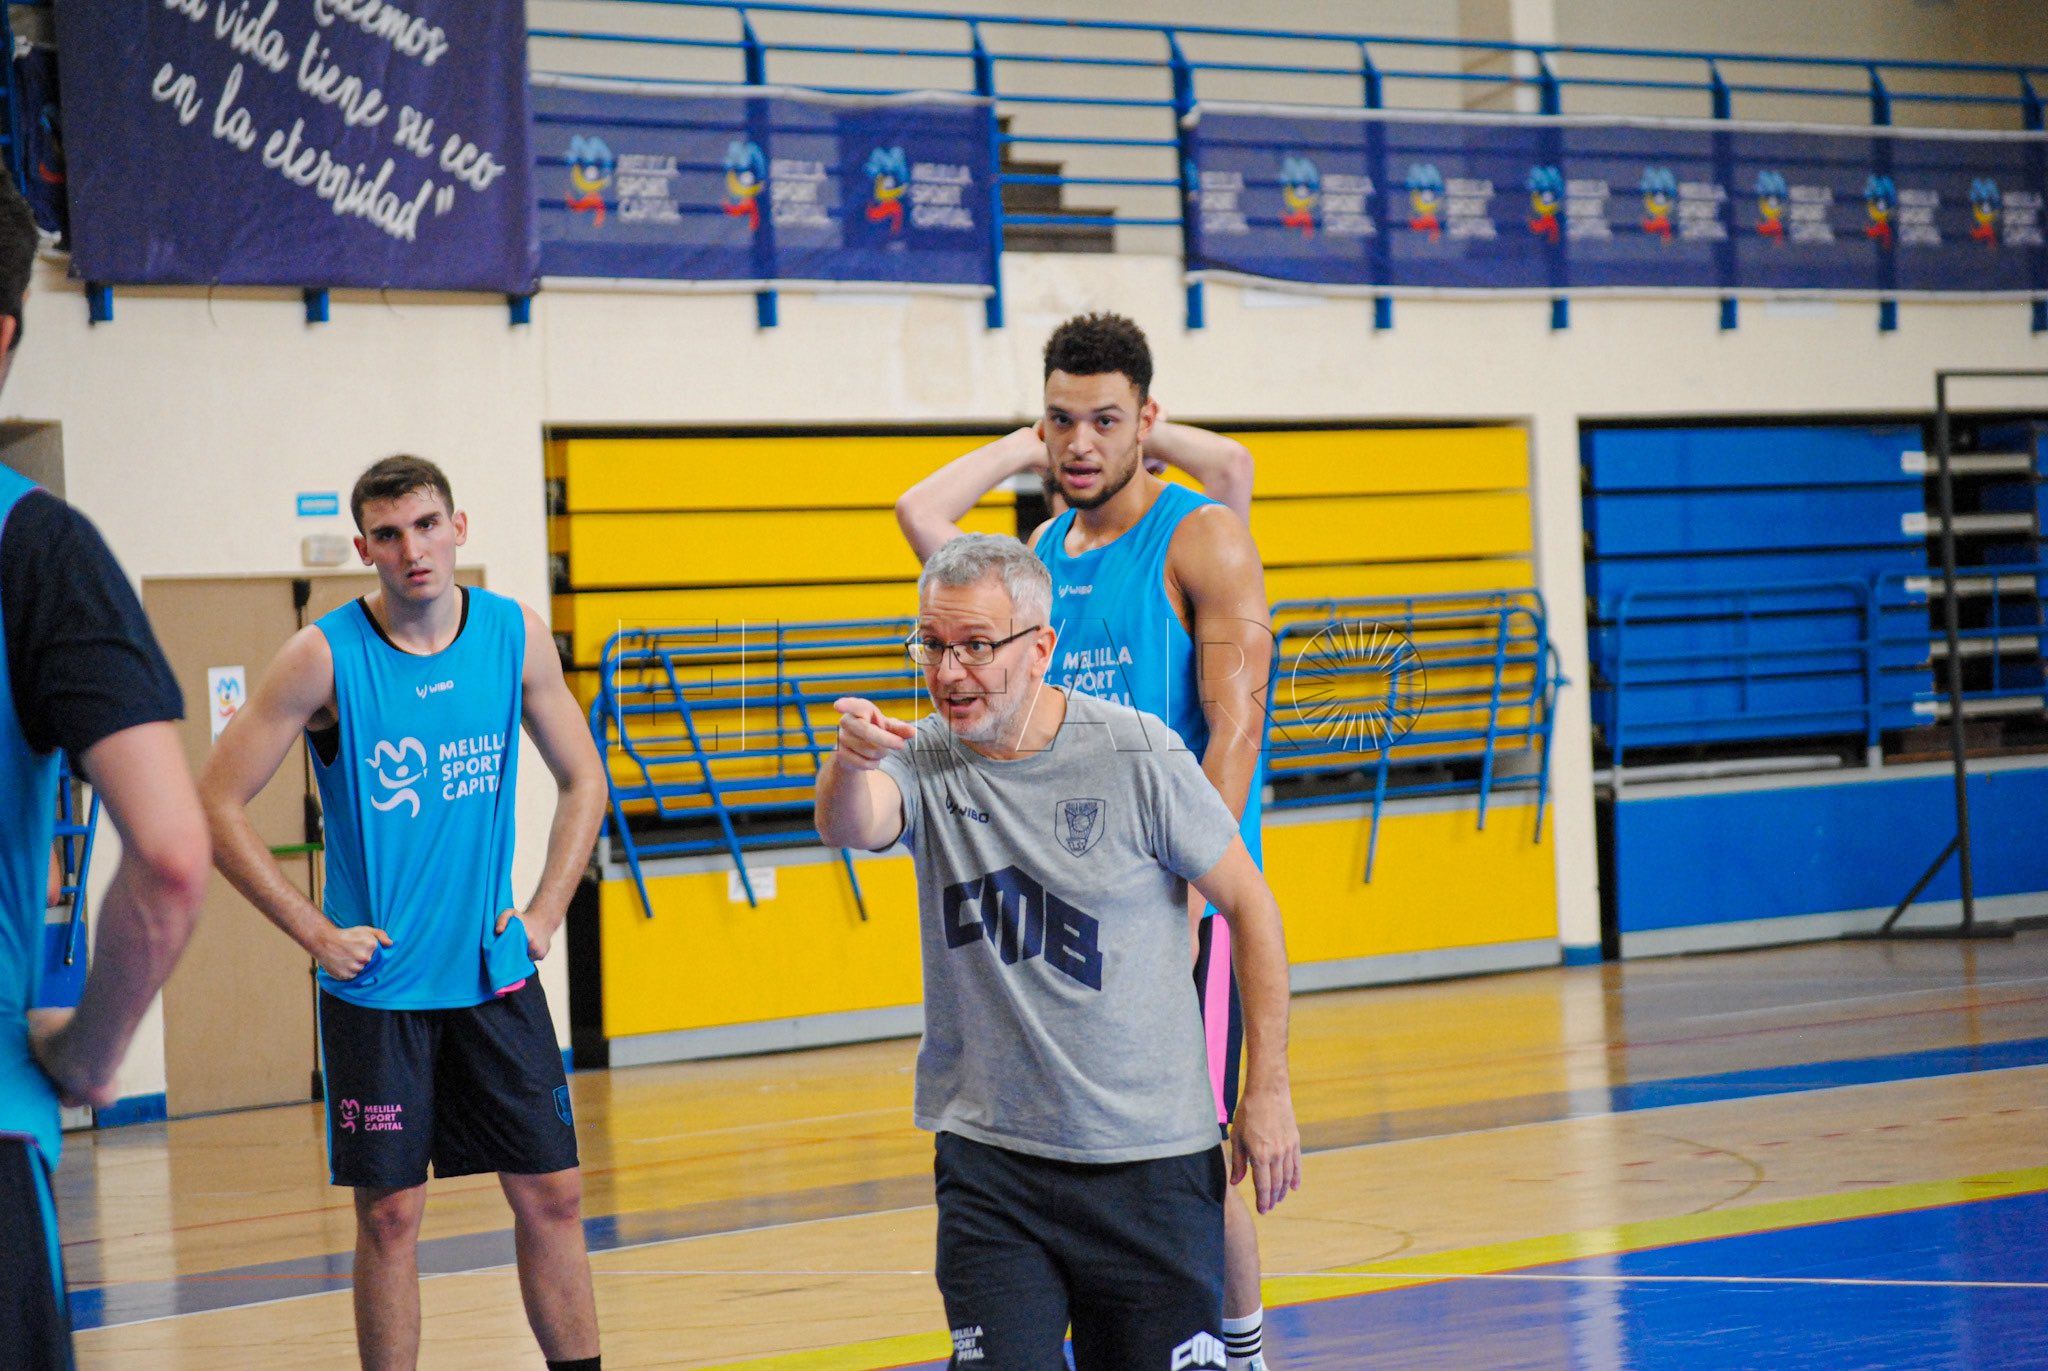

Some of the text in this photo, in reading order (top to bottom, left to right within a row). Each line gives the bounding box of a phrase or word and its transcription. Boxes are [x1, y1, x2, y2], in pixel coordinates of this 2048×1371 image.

[152, 62, 204, 126] en
[212, 62, 257, 150] la
[214, 0, 506, 192] vida tiene su eco
[1062, 646, 1134, 671] MELILLA
[429, 680, 455, 693] WIBO
[1062, 669, 1116, 691] SPORT
[943, 864, 1103, 992] CMB
[365, 1104, 402, 1113] MELILLA
[365, 1113, 396, 1122] SPORT
[365, 1122, 403, 1131] CAPITAL
